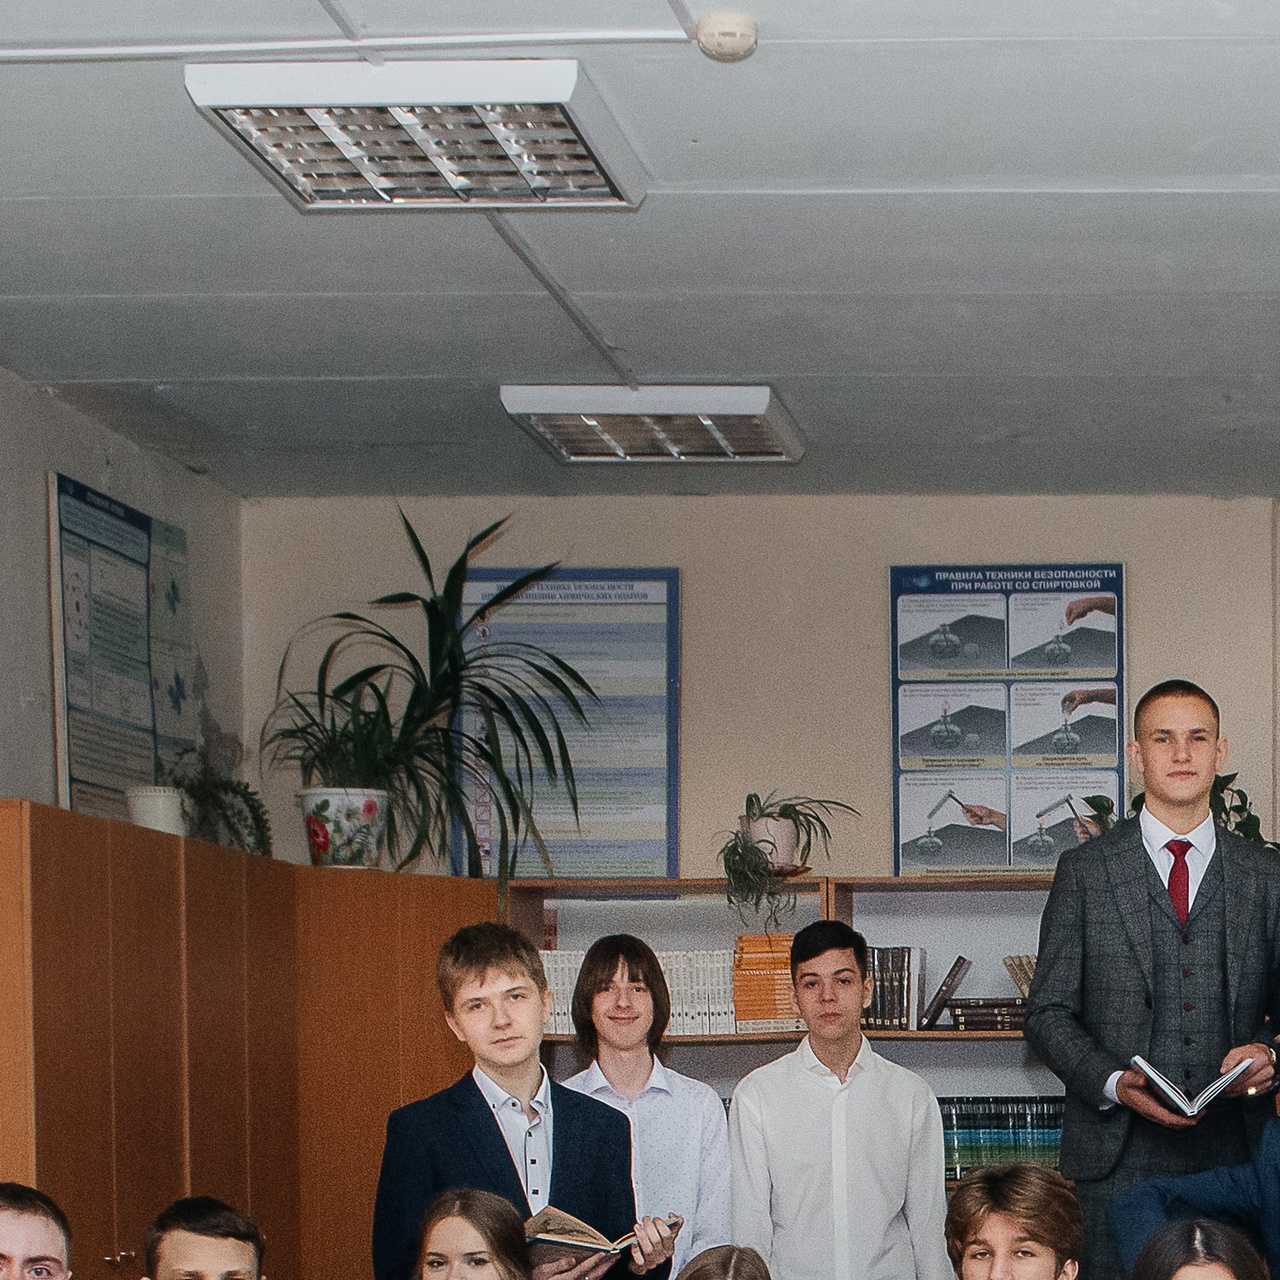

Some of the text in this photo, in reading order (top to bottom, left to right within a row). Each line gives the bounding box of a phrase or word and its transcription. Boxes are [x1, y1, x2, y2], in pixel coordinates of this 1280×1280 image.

[935, 569, 1116, 581] ПРАВИЛА ТЕХНИКИ БЕЗОПАСНОСТИ
[951, 579, 1101, 590] ПРИ РАБОТЕ СО СПИРТОВКОЙ
